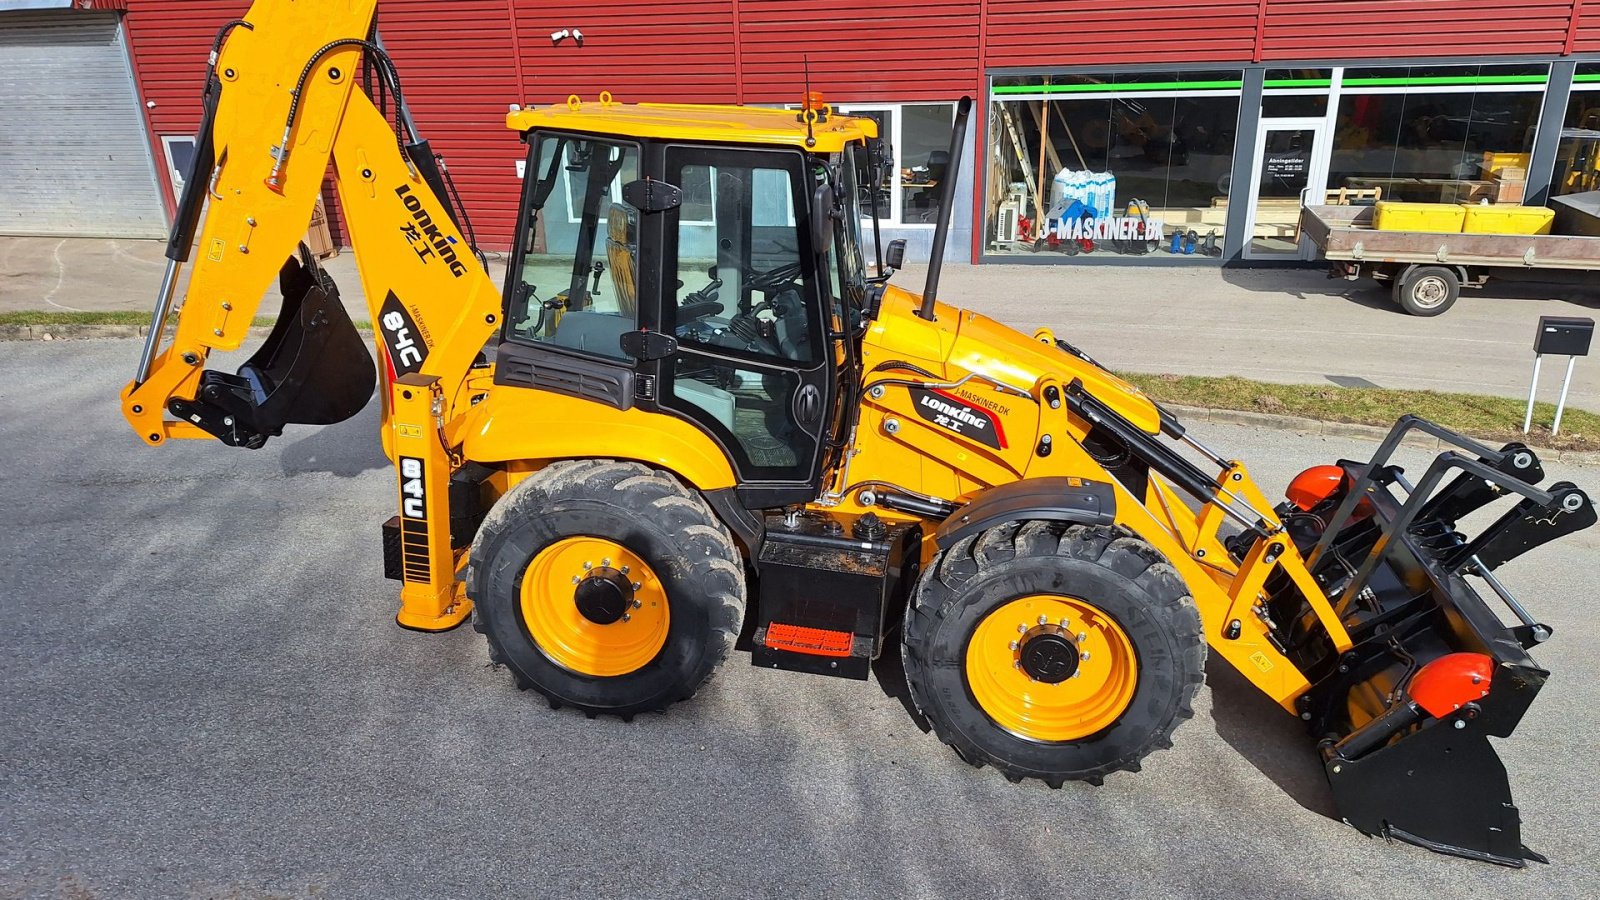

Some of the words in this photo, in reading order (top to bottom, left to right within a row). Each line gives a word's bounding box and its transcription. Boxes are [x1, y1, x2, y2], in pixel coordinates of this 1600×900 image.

[1039, 217, 1165, 240] J-MASKINER.DK
[383, 311, 422, 367] 84C
[410, 304, 435, 348] J-MASKINER.DK
[954, 388, 1010, 416] J-MASKINER.DK
[401, 458, 424, 518] 84C
